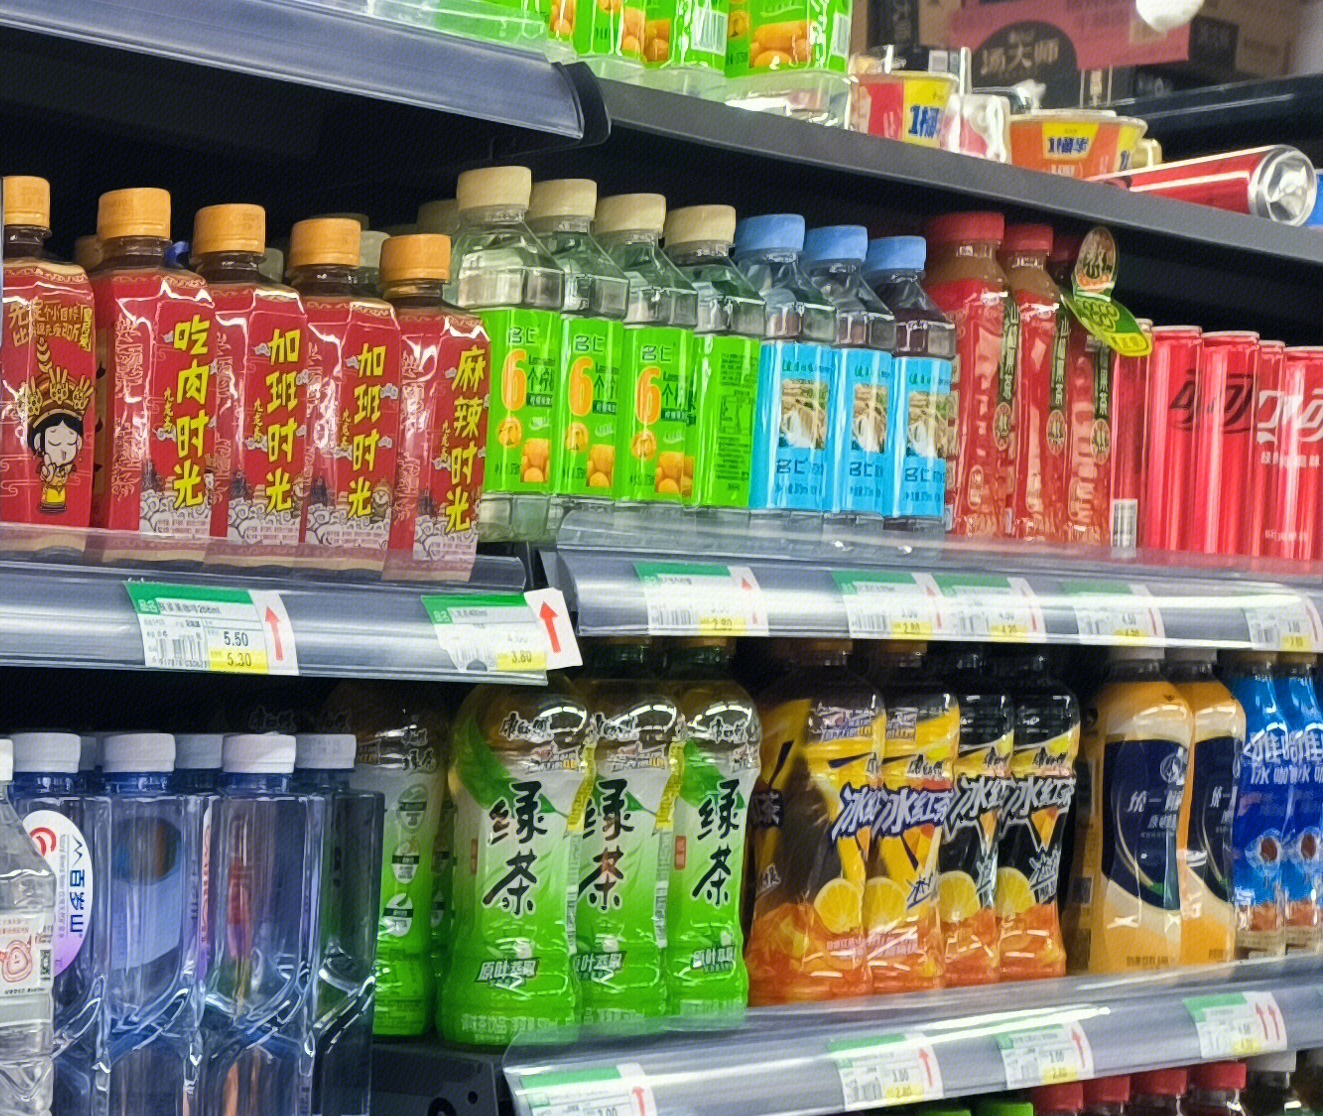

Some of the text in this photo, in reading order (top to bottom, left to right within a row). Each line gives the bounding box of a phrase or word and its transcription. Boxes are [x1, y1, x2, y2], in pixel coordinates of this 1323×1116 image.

[173, 315, 211, 510] 吃肉时光
[265, 327, 301, 514] 加班时光
[347, 343, 387, 521] 加班时光
[445, 345, 487, 533] 麻辣时光
[501, 349, 527, 411] 6
[569, 357, 594, 416] 6
[635, 368, 661, 425] 6
[224, 631, 249, 648] 5.50
[227, 651, 252, 667] 5.30
[483, 780, 548, 918] 绿茶
[693, 778, 740, 908] 绿茶
